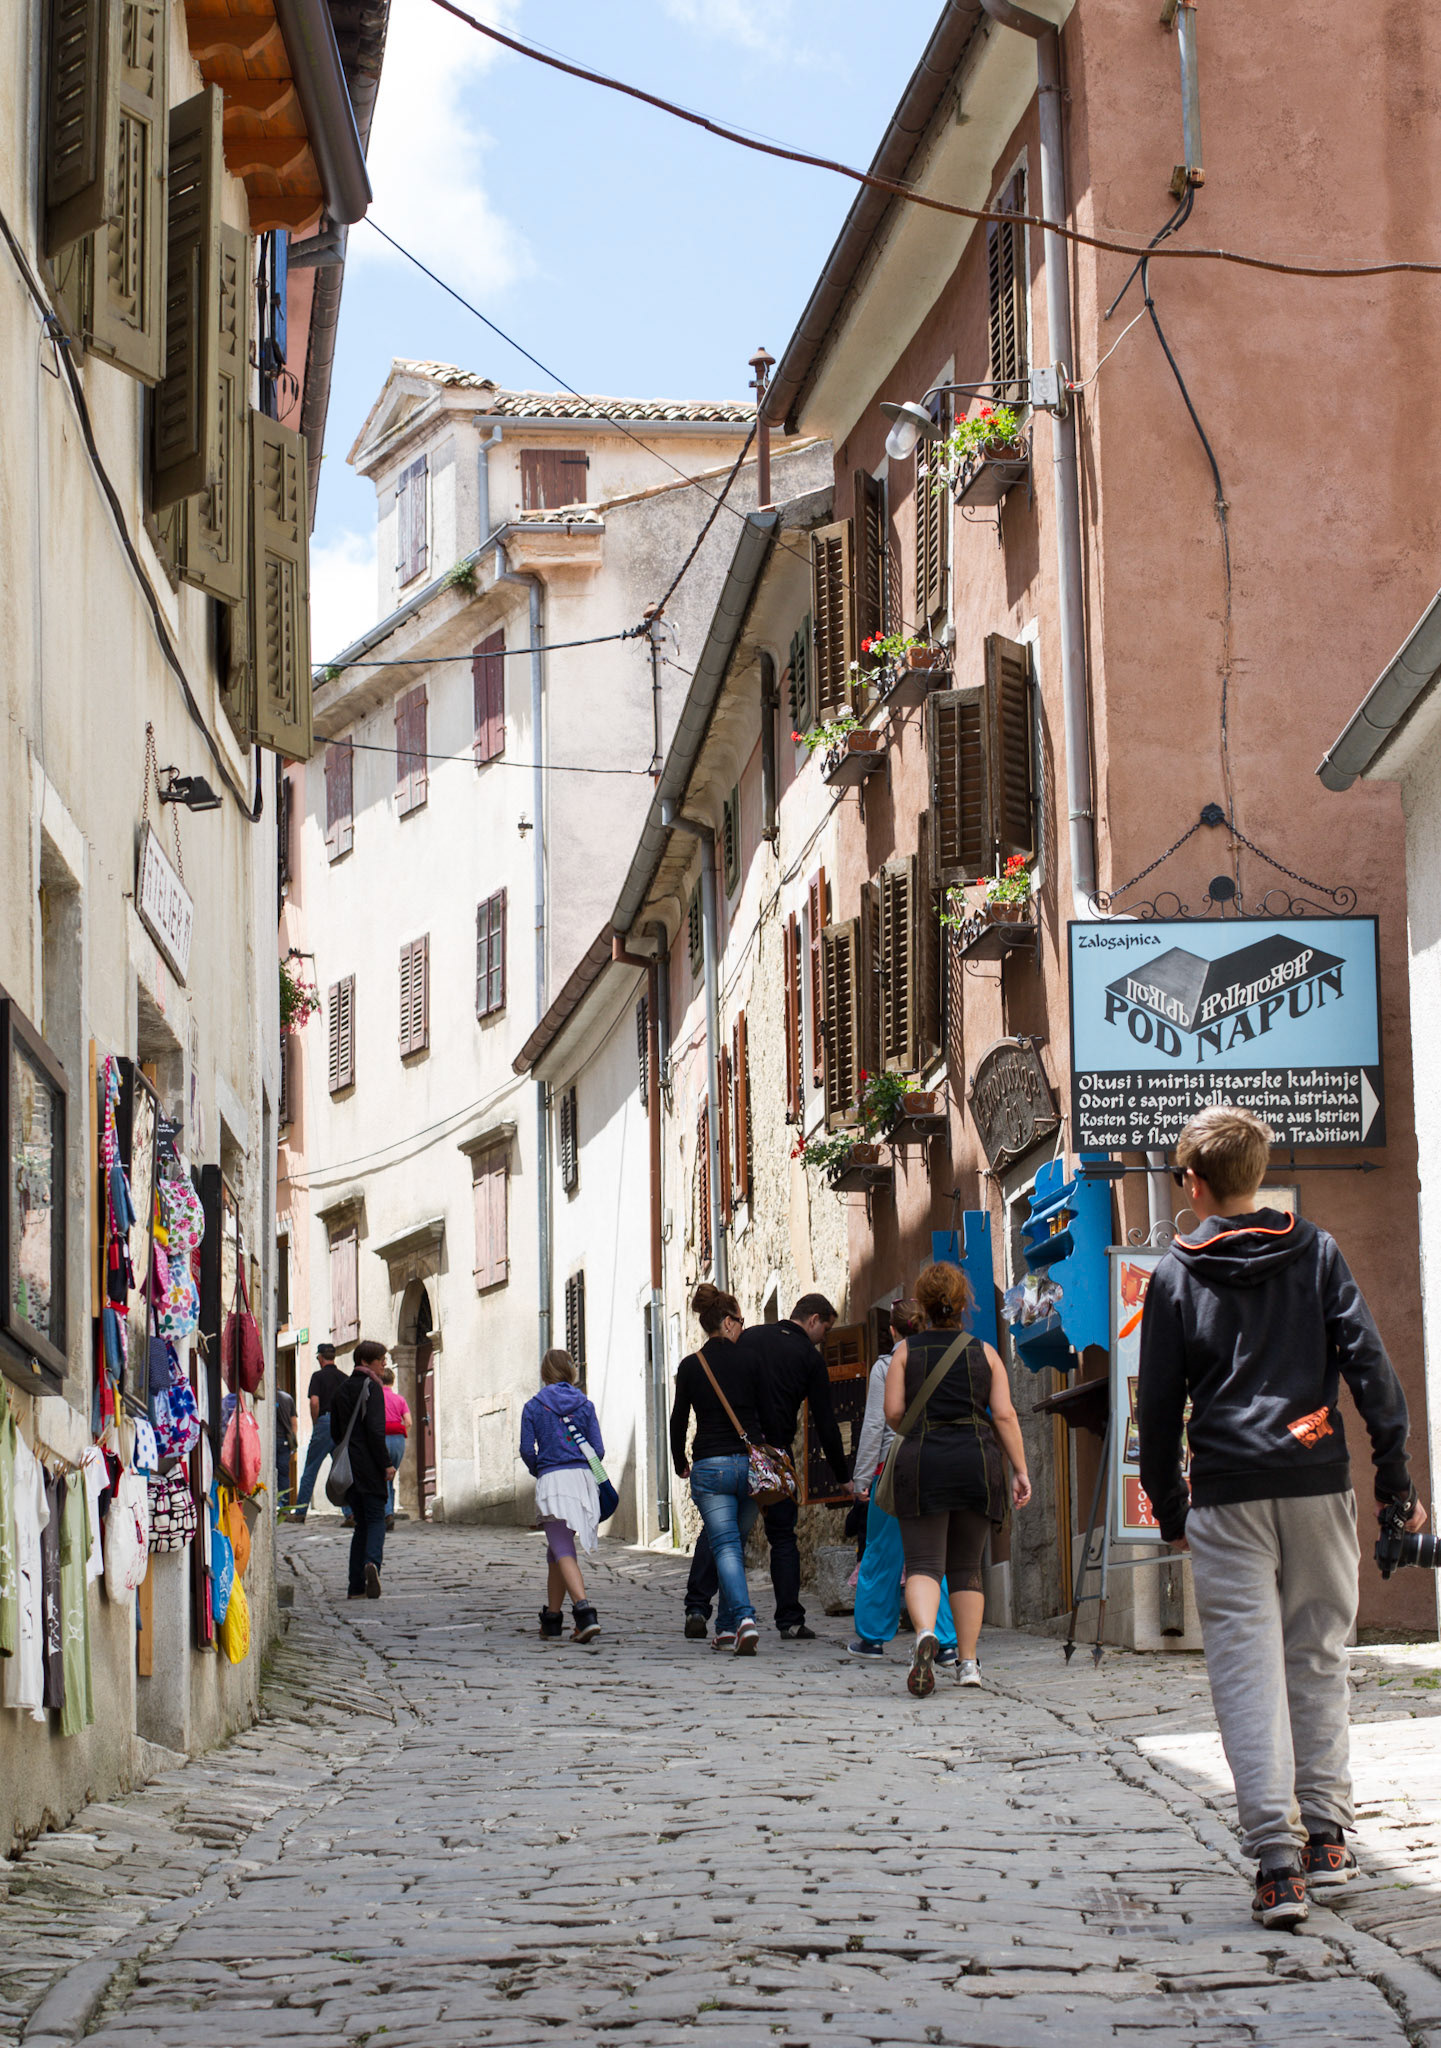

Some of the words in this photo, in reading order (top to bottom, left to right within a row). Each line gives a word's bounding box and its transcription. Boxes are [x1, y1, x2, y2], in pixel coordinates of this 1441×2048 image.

[1078, 933, 1161, 950] Zalogajnica
[1104, 989, 1182, 1058] POD
[1196, 965, 1345, 1065] NAPUN
[1078, 1073, 1131, 1091] Okusi
[1137, 1075, 1142, 1089] i
[1148, 1073, 1205, 1090] mirisi
[1209, 1070, 1282, 1090] istarske
[1287, 1069, 1359, 1091] kuhinje
[1079, 1093, 1124, 1109] Odori
[1127, 1095, 1136, 1107] e
[1140, 1092, 1191, 1111] sapori
[1194, 1089, 1233, 1107] della
[1236, 1090, 1291, 1106] cucina
[1294, 1090, 1359, 1106] istriana
[1079, 1112, 1126, 1127] Kosten
[1129, 1111, 1150, 1126] Sie
[1253, 1109, 1284, 1123] eine
[1287, 1111, 1312, 1123] aus
[1314, 1109, 1360, 1123] Istrien
[1080, 1130, 1127, 1146] Tastes
[1131, 1130, 1144, 1145] &
[1147, 1127, 1181, 1145] flav
[1289, 1127, 1360, 1143] Tradition
